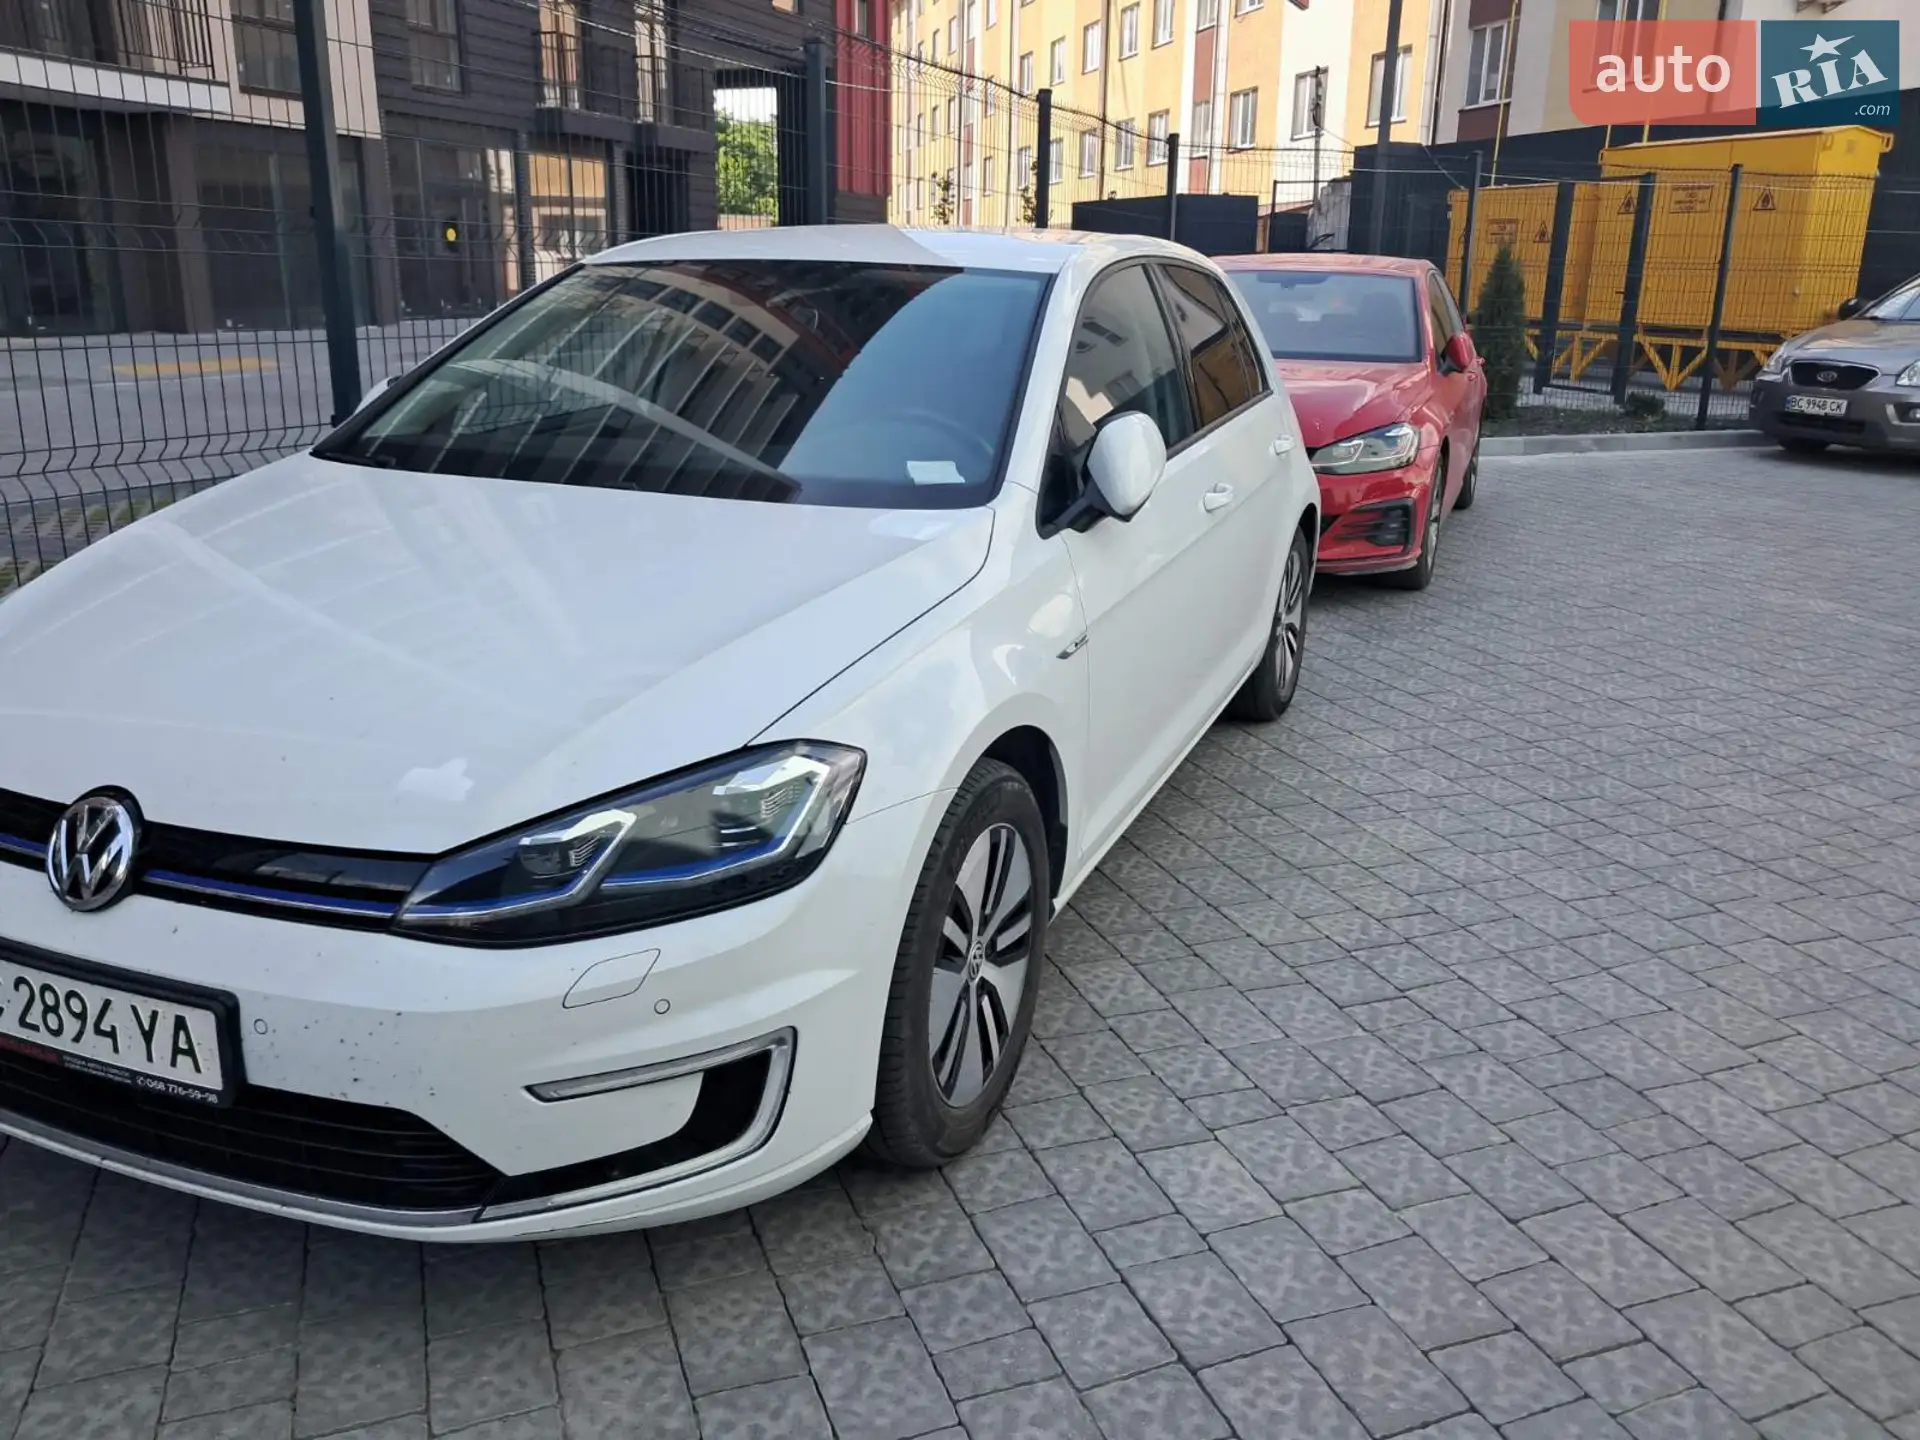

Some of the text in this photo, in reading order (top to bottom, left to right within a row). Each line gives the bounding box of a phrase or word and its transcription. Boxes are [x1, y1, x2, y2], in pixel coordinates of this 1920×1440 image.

[1791, 397, 1804, 408] BC
[1830, 401, 1844, 412] CK
[13, 976, 119, 1054] 2894
[130, 1004, 202, 1074] YA
